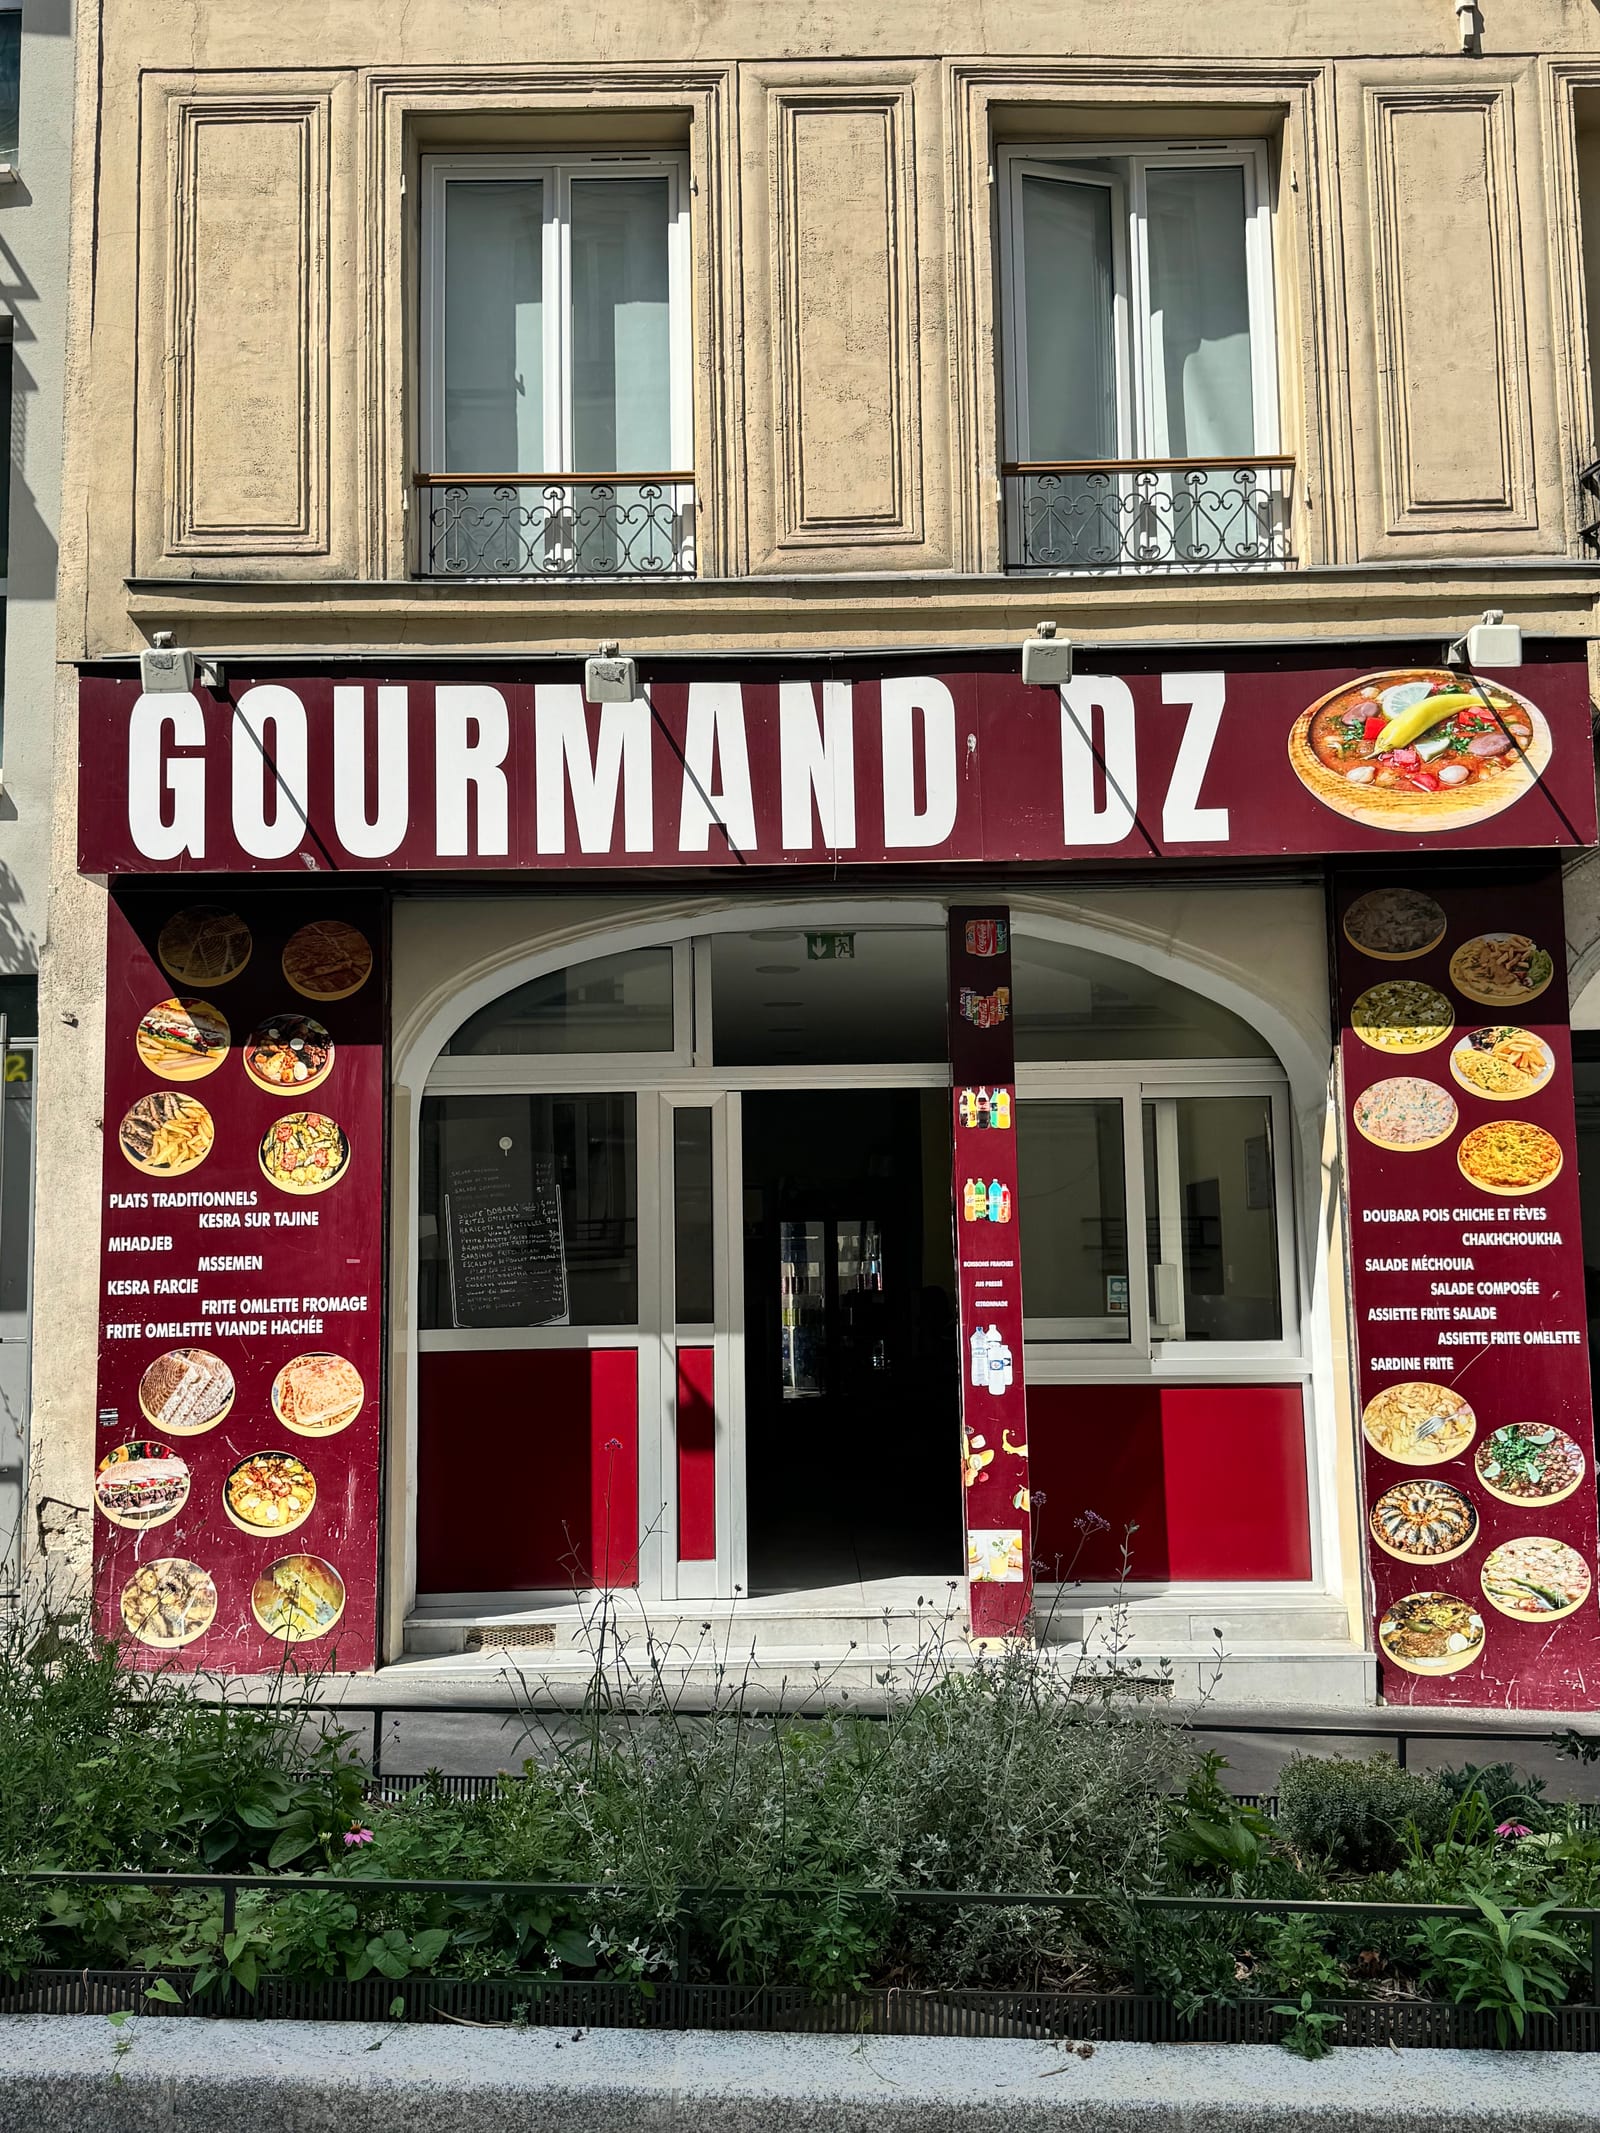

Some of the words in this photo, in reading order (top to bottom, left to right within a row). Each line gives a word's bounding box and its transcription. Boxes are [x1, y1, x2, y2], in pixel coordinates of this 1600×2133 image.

[128, 677, 957, 860] GOURMAND
[1062, 671, 1230, 846] DZ
[110, 1193, 148, 1208] PLATS
[152, 1191, 257, 1207] TRADITIONNELS
[199, 1213, 241, 1228] KESRA
[245, 1213, 270, 1227] SUR
[274, 1212, 318, 1226] TAJINE
[1363, 1209, 1420, 1222] DOUBARA
[1423, 1209, 1449, 1221] POIS
[1453, 1209, 1494, 1221] CHICHE
[1497, 1208, 1510, 1220] ET
[1513, 1204, 1546, 1220] FÈVES
[108, 1236, 172, 1251] MHADJEB
[1462, 1232, 1562, 1245] CHAKHCHOUKHA
[198, 1256, 262, 1271] MSSEMEN
[1366, 1259, 1408, 1271] SALADE
[1412, 1255, 1474, 1270] MÉCHOUIA
[108, 1280, 150, 1295] KESRA
[154, 1279, 198, 1294] FARCIE
[1431, 1283, 1474, 1295] SALADE
[1477, 1278, 1539, 1295] COMPOSÉE
[202, 1300, 236, 1314] FRITE
[240, 1298, 298, 1313] OMLETTE
[303, 1296, 367, 1312] FROMAGE
[1368, 1308, 1418, 1321] ASSIETTE
[1421, 1308, 1450, 1320] FRITE
[1453, 1307, 1496, 1320] SALADE
[106, 1324, 141, 1339] FRITE
[145, 1322, 211, 1338] OMELETTE
[215, 1321, 267, 1336] VIANDE
[271, 1315, 323, 1334] HACHÉE
[1438, 1332, 1488, 1345] ASSIETTE
[1491, 1332, 1521, 1345] FRITE
[1523, 1331, 1580, 1344] OMELETTE
[1371, 1358, 1421, 1370] SARDINE
[1424, 1357, 1453, 1369] FRITE
